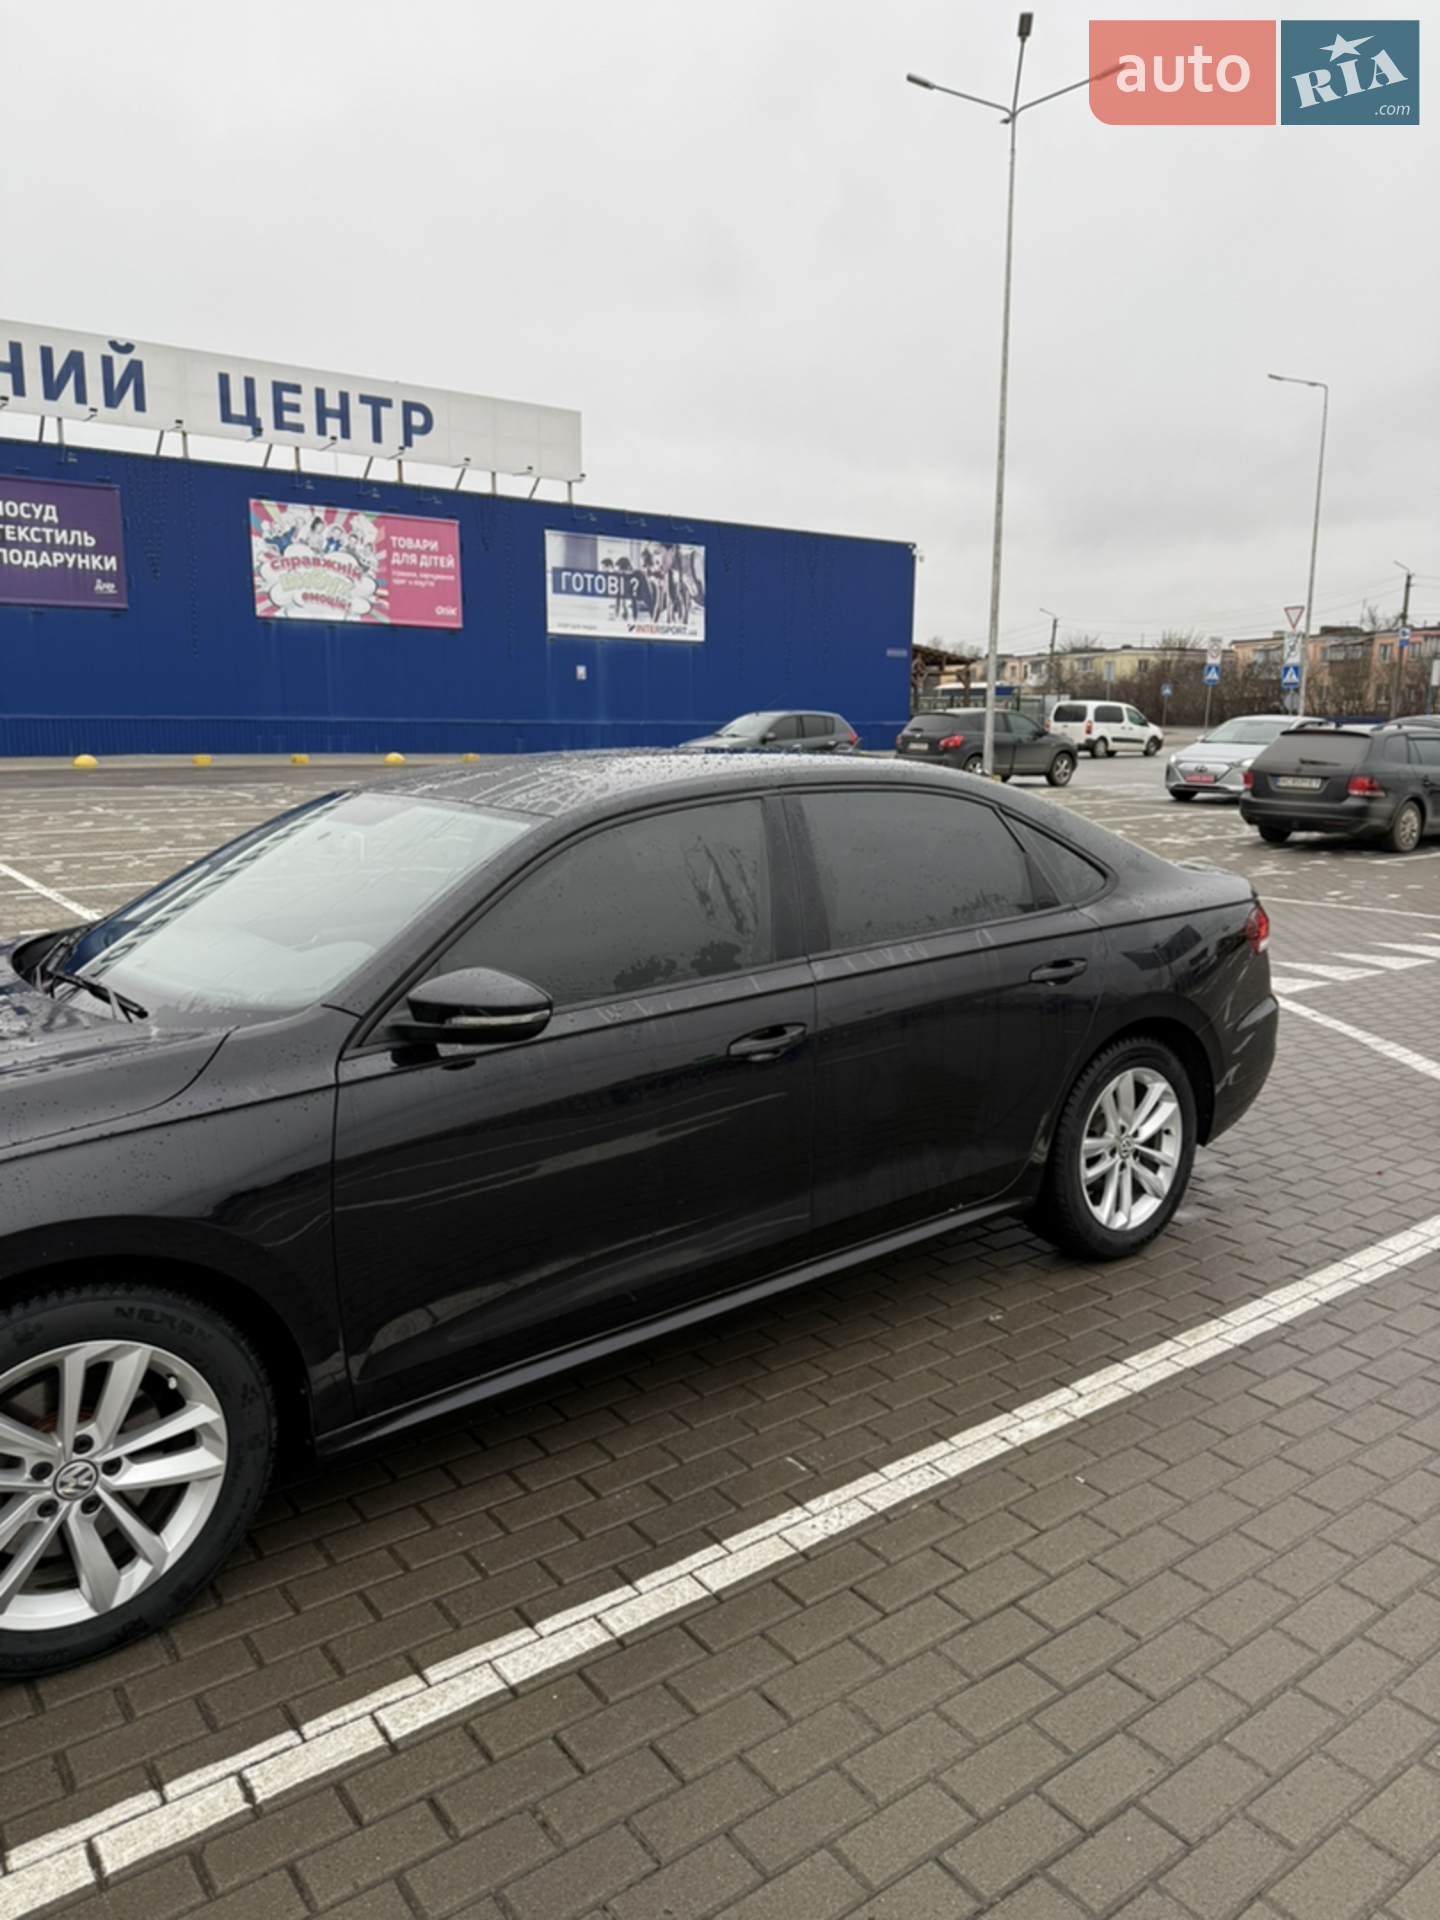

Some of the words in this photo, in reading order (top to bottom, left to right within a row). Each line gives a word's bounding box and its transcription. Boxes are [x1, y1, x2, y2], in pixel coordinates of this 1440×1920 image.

[218, 372, 434, 448] ЦЕНТР
[0, 500, 59, 523] ОСУД
[390, 536, 439, 552] ТОВАРИ
[391, 552, 418, 566] ДЛЯ
[419, 554, 455, 569] ДІТЕЙ
[561, 571, 625, 596] ГОТОВІ
